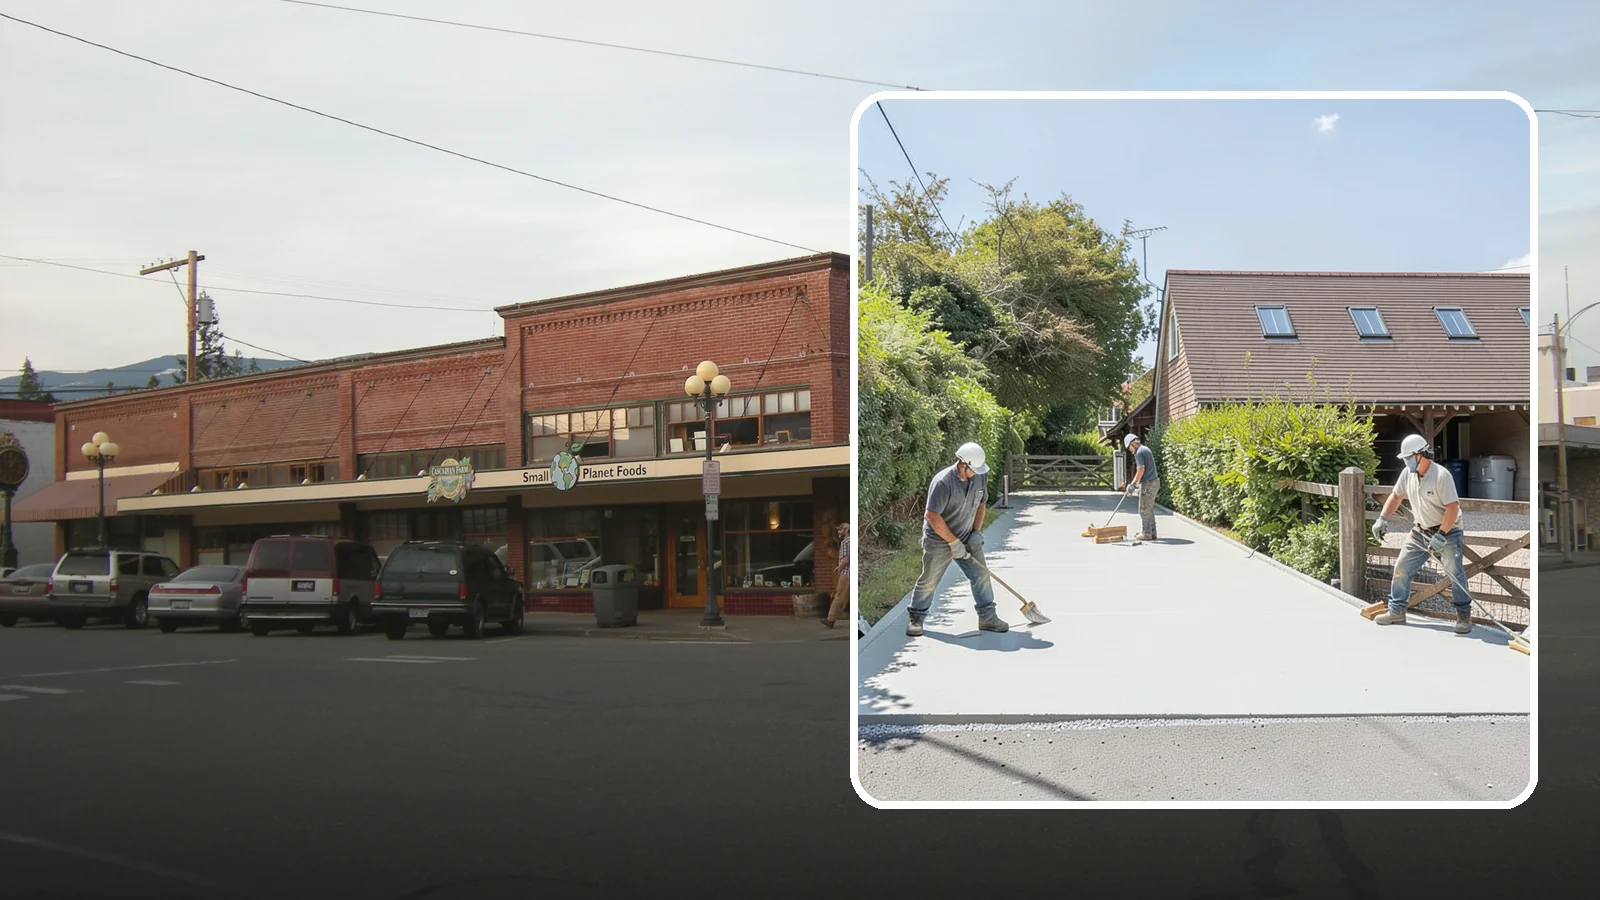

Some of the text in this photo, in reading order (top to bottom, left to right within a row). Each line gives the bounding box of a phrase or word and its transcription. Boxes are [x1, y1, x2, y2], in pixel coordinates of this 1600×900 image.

[523, 464, 647, 483] Small Planet Foods
